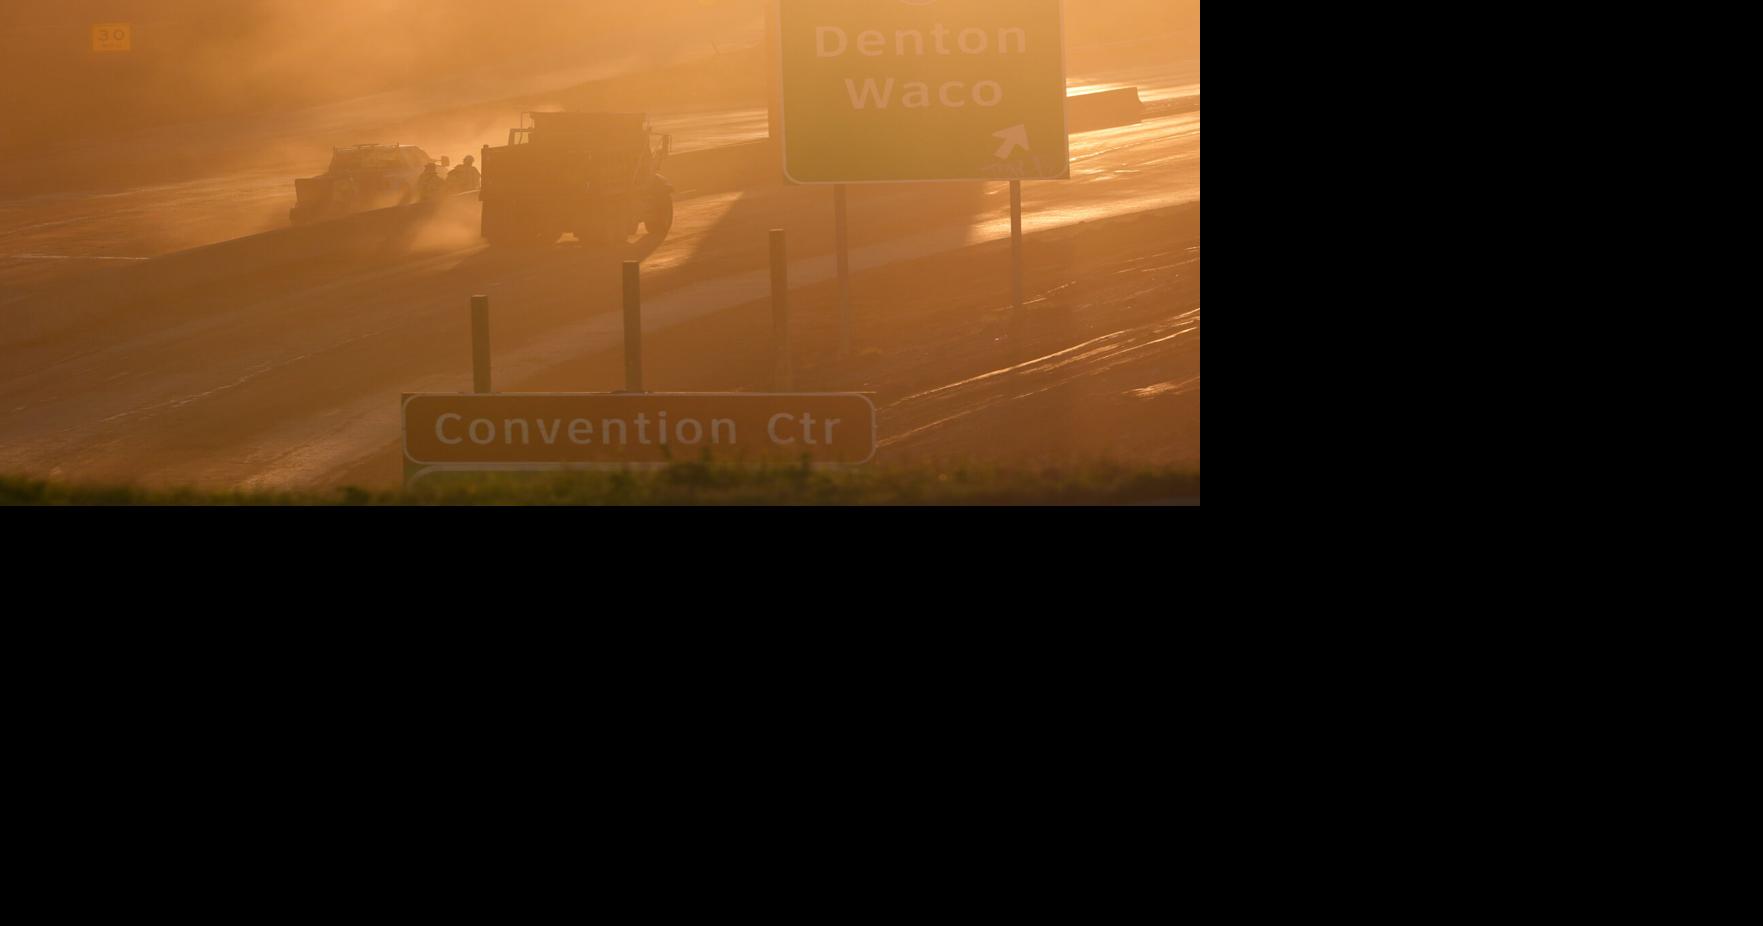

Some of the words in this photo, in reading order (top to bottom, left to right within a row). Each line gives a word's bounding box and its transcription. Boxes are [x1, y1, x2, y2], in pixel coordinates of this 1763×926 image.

[98, 29, 125, 41] 30
[815, 23, 1027, 57] Denton
[845, 77, 1004, 110] Waco
[434, 411, 737, 445] Convention
[767, 411, 842, 445] Ctr
